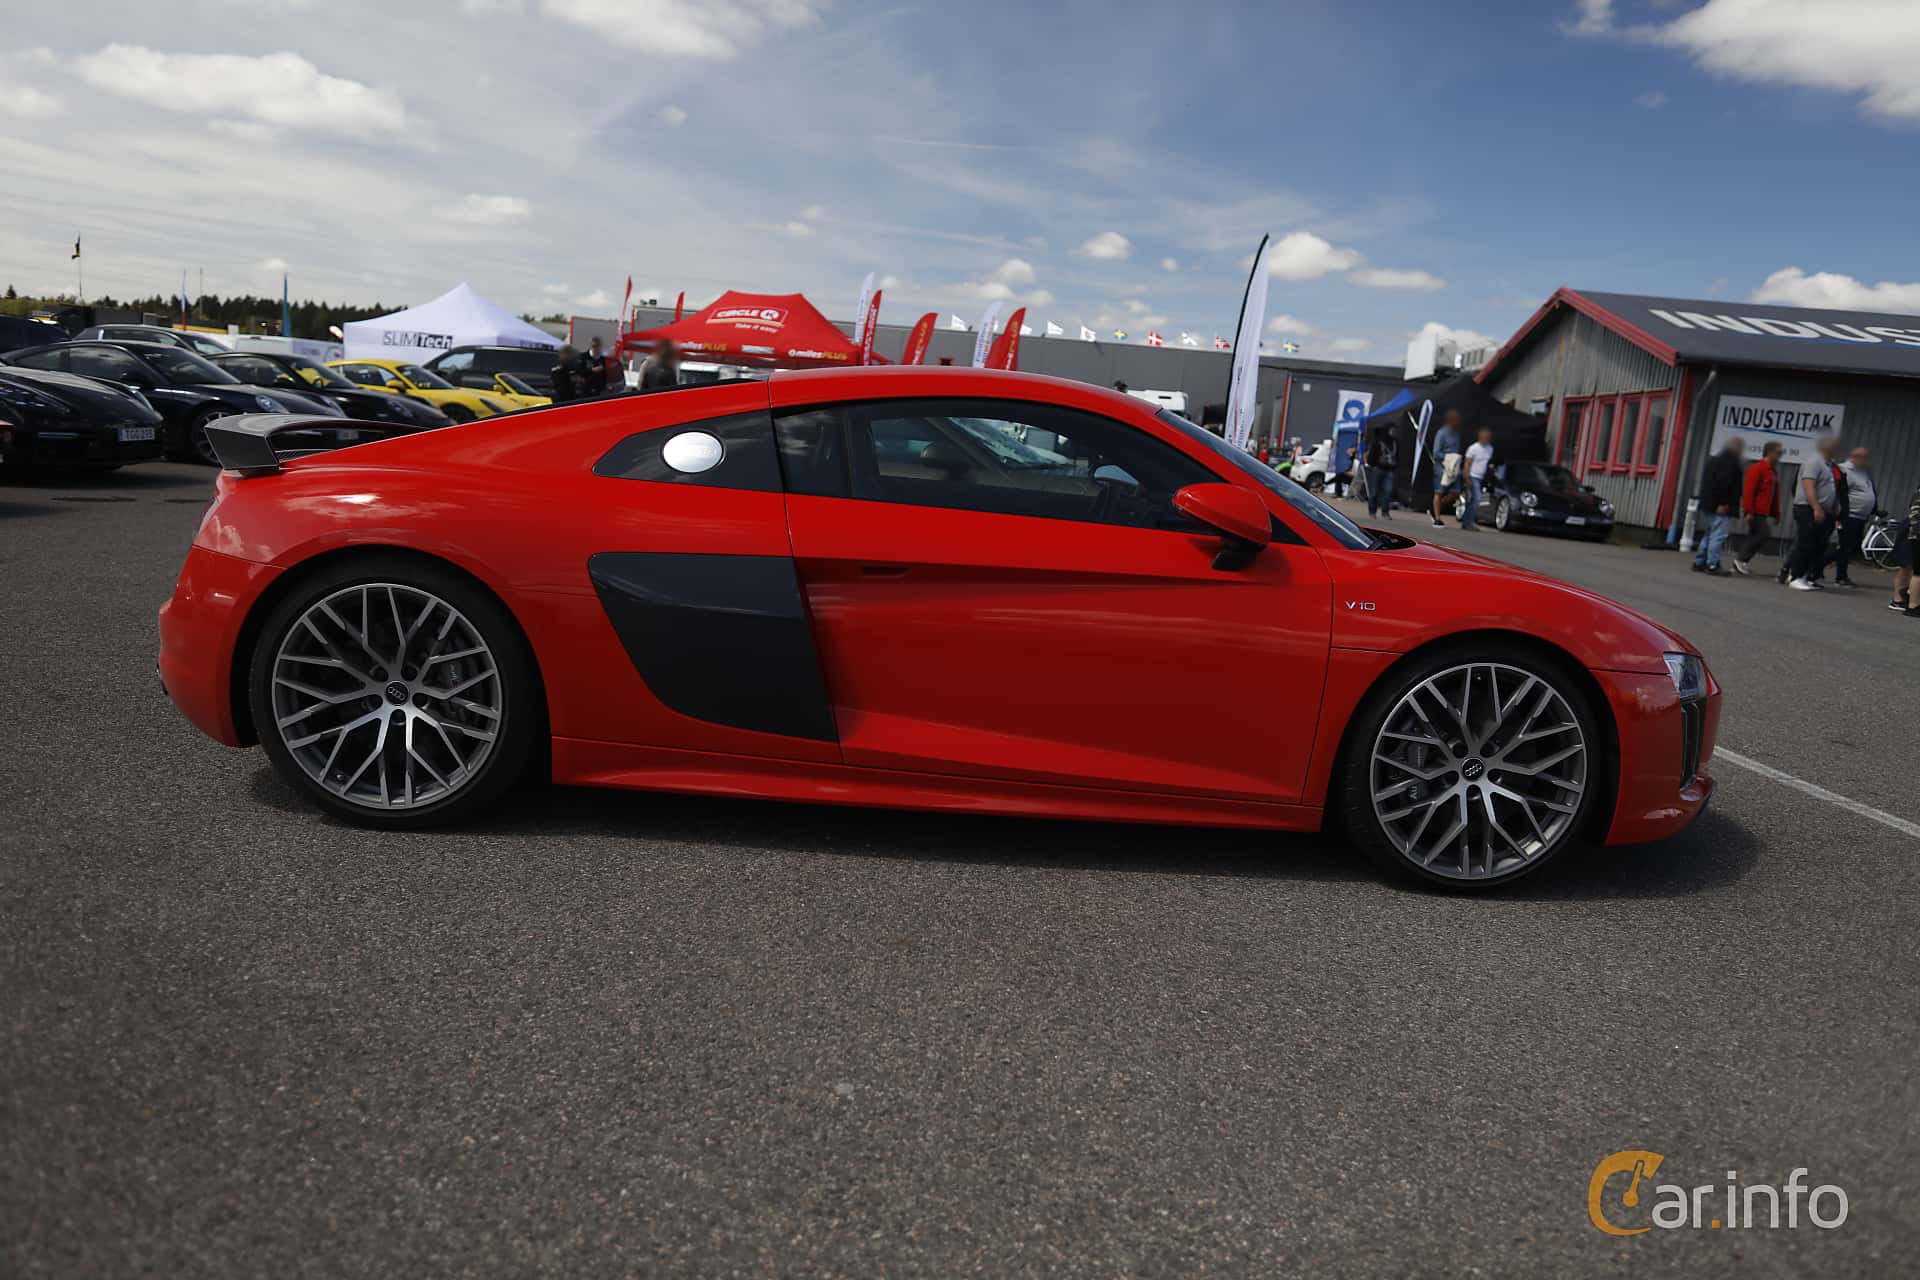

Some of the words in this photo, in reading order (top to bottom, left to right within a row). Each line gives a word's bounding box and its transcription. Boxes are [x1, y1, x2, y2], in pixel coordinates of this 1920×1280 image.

[716, 309, 760, 318] CIRCLE
[1648, 309, 1920, 346] INDUS
[383, 331, 453, 349] SLIMTech
[1722, 405, 1835, 432] INDUSTRITAK
[1345, 601, 1376, 611] V10
